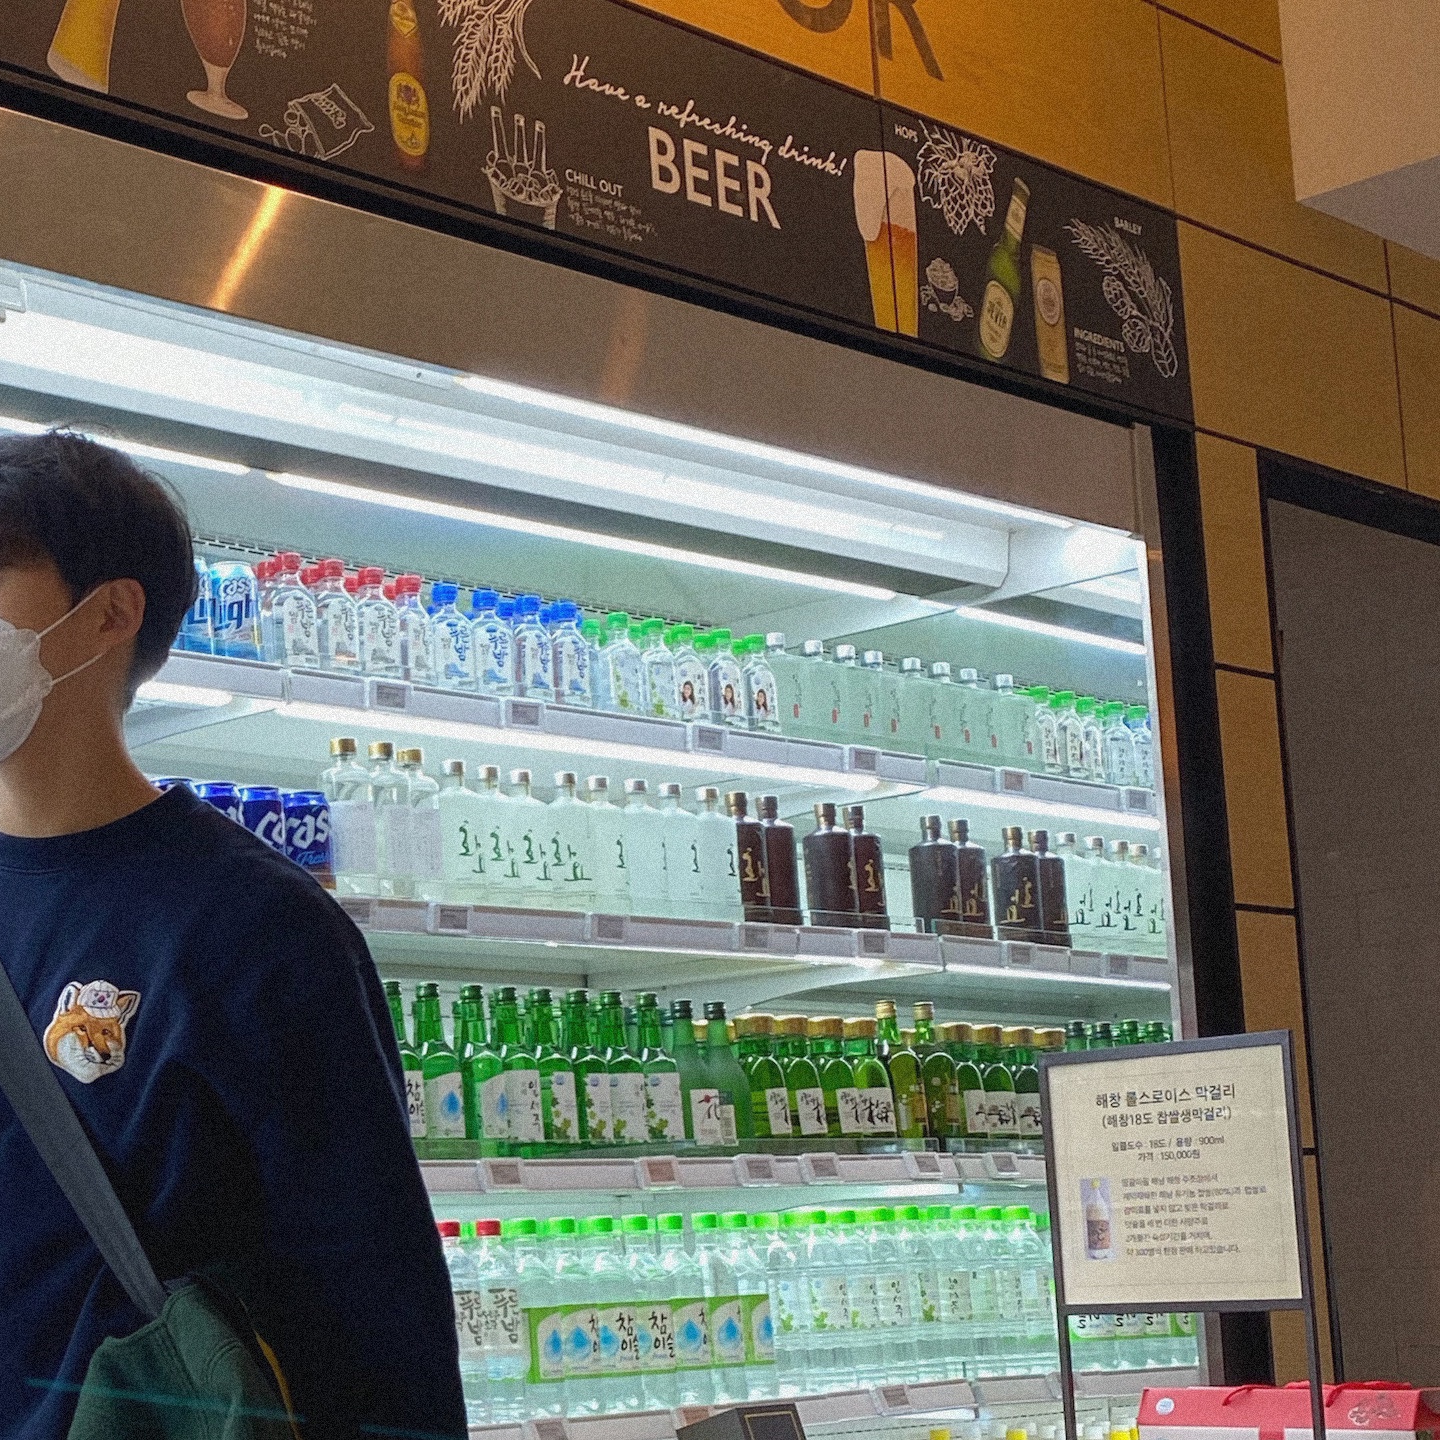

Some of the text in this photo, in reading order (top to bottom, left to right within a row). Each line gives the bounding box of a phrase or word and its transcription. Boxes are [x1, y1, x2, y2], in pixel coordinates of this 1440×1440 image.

[563, 54, 848, 177] Have a refreshing drink!
[894, 123, 919, 143] HOPS
[565, 169, 623, 199] CHILL OUT
[647, 126, 782, 230] BEER
[1096, 1092, 1122, 1109] 해창
[1195, 1083, 1236, 1102] 막걸리
[615, 1311, 634, 1337] 참
[647, 1310, 668, 1335] 참
[652, 1331, 676, 1359] 이슬
